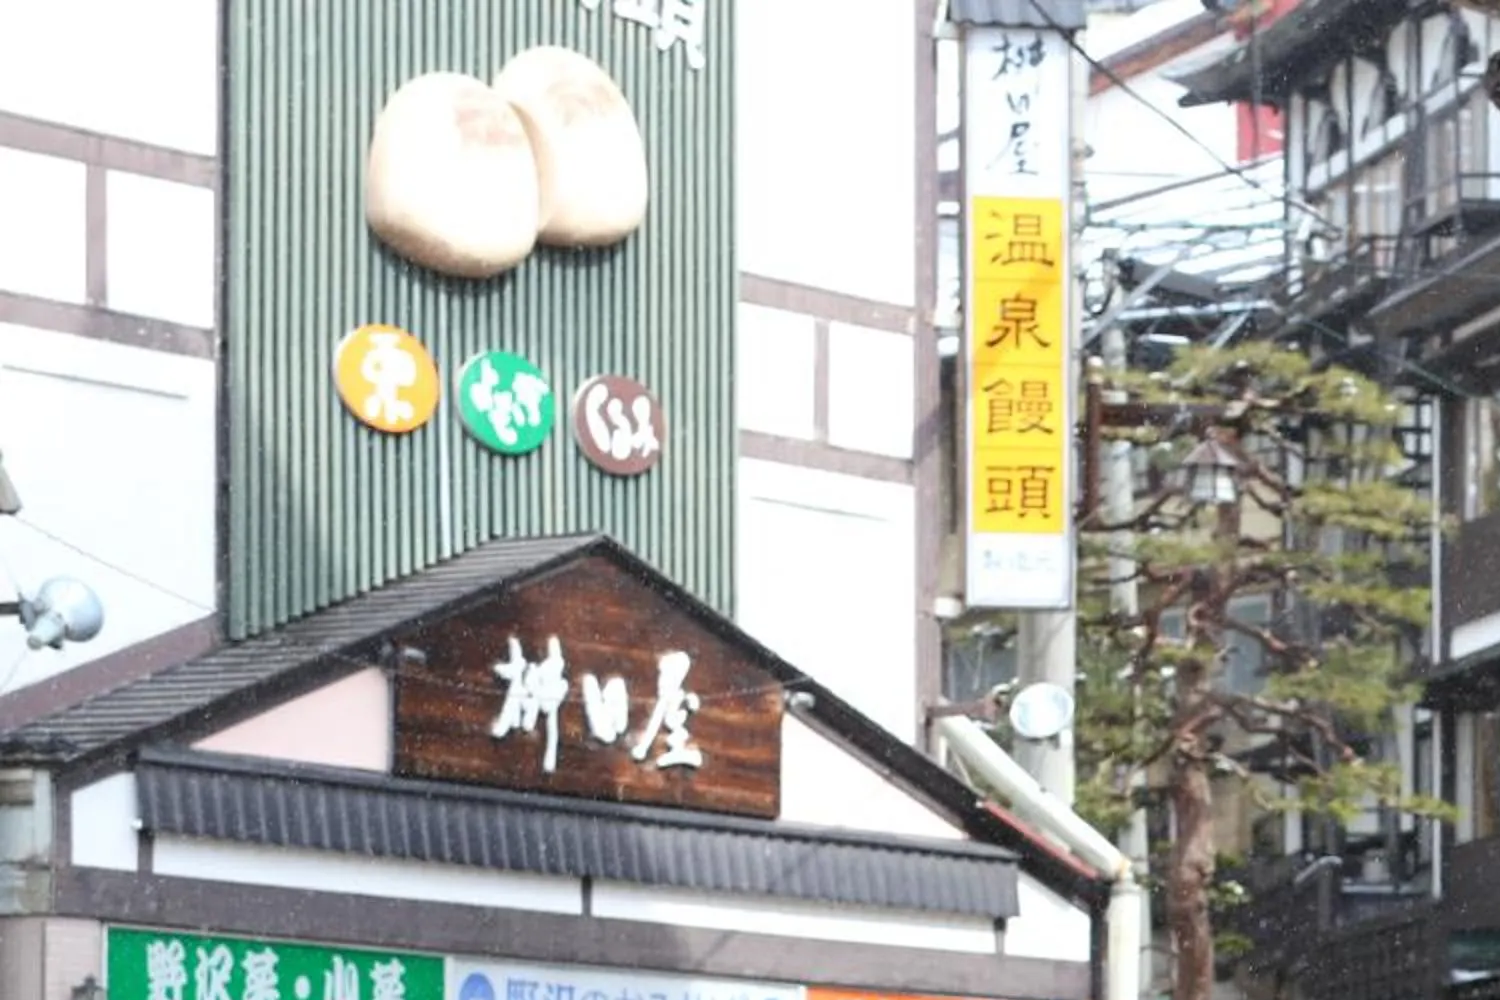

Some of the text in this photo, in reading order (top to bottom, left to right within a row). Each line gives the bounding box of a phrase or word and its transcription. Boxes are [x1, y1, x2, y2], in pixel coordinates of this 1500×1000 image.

[586, 382, 660, 460] くるみ
[983, 210, 1056, 519] 温泉饅頭
